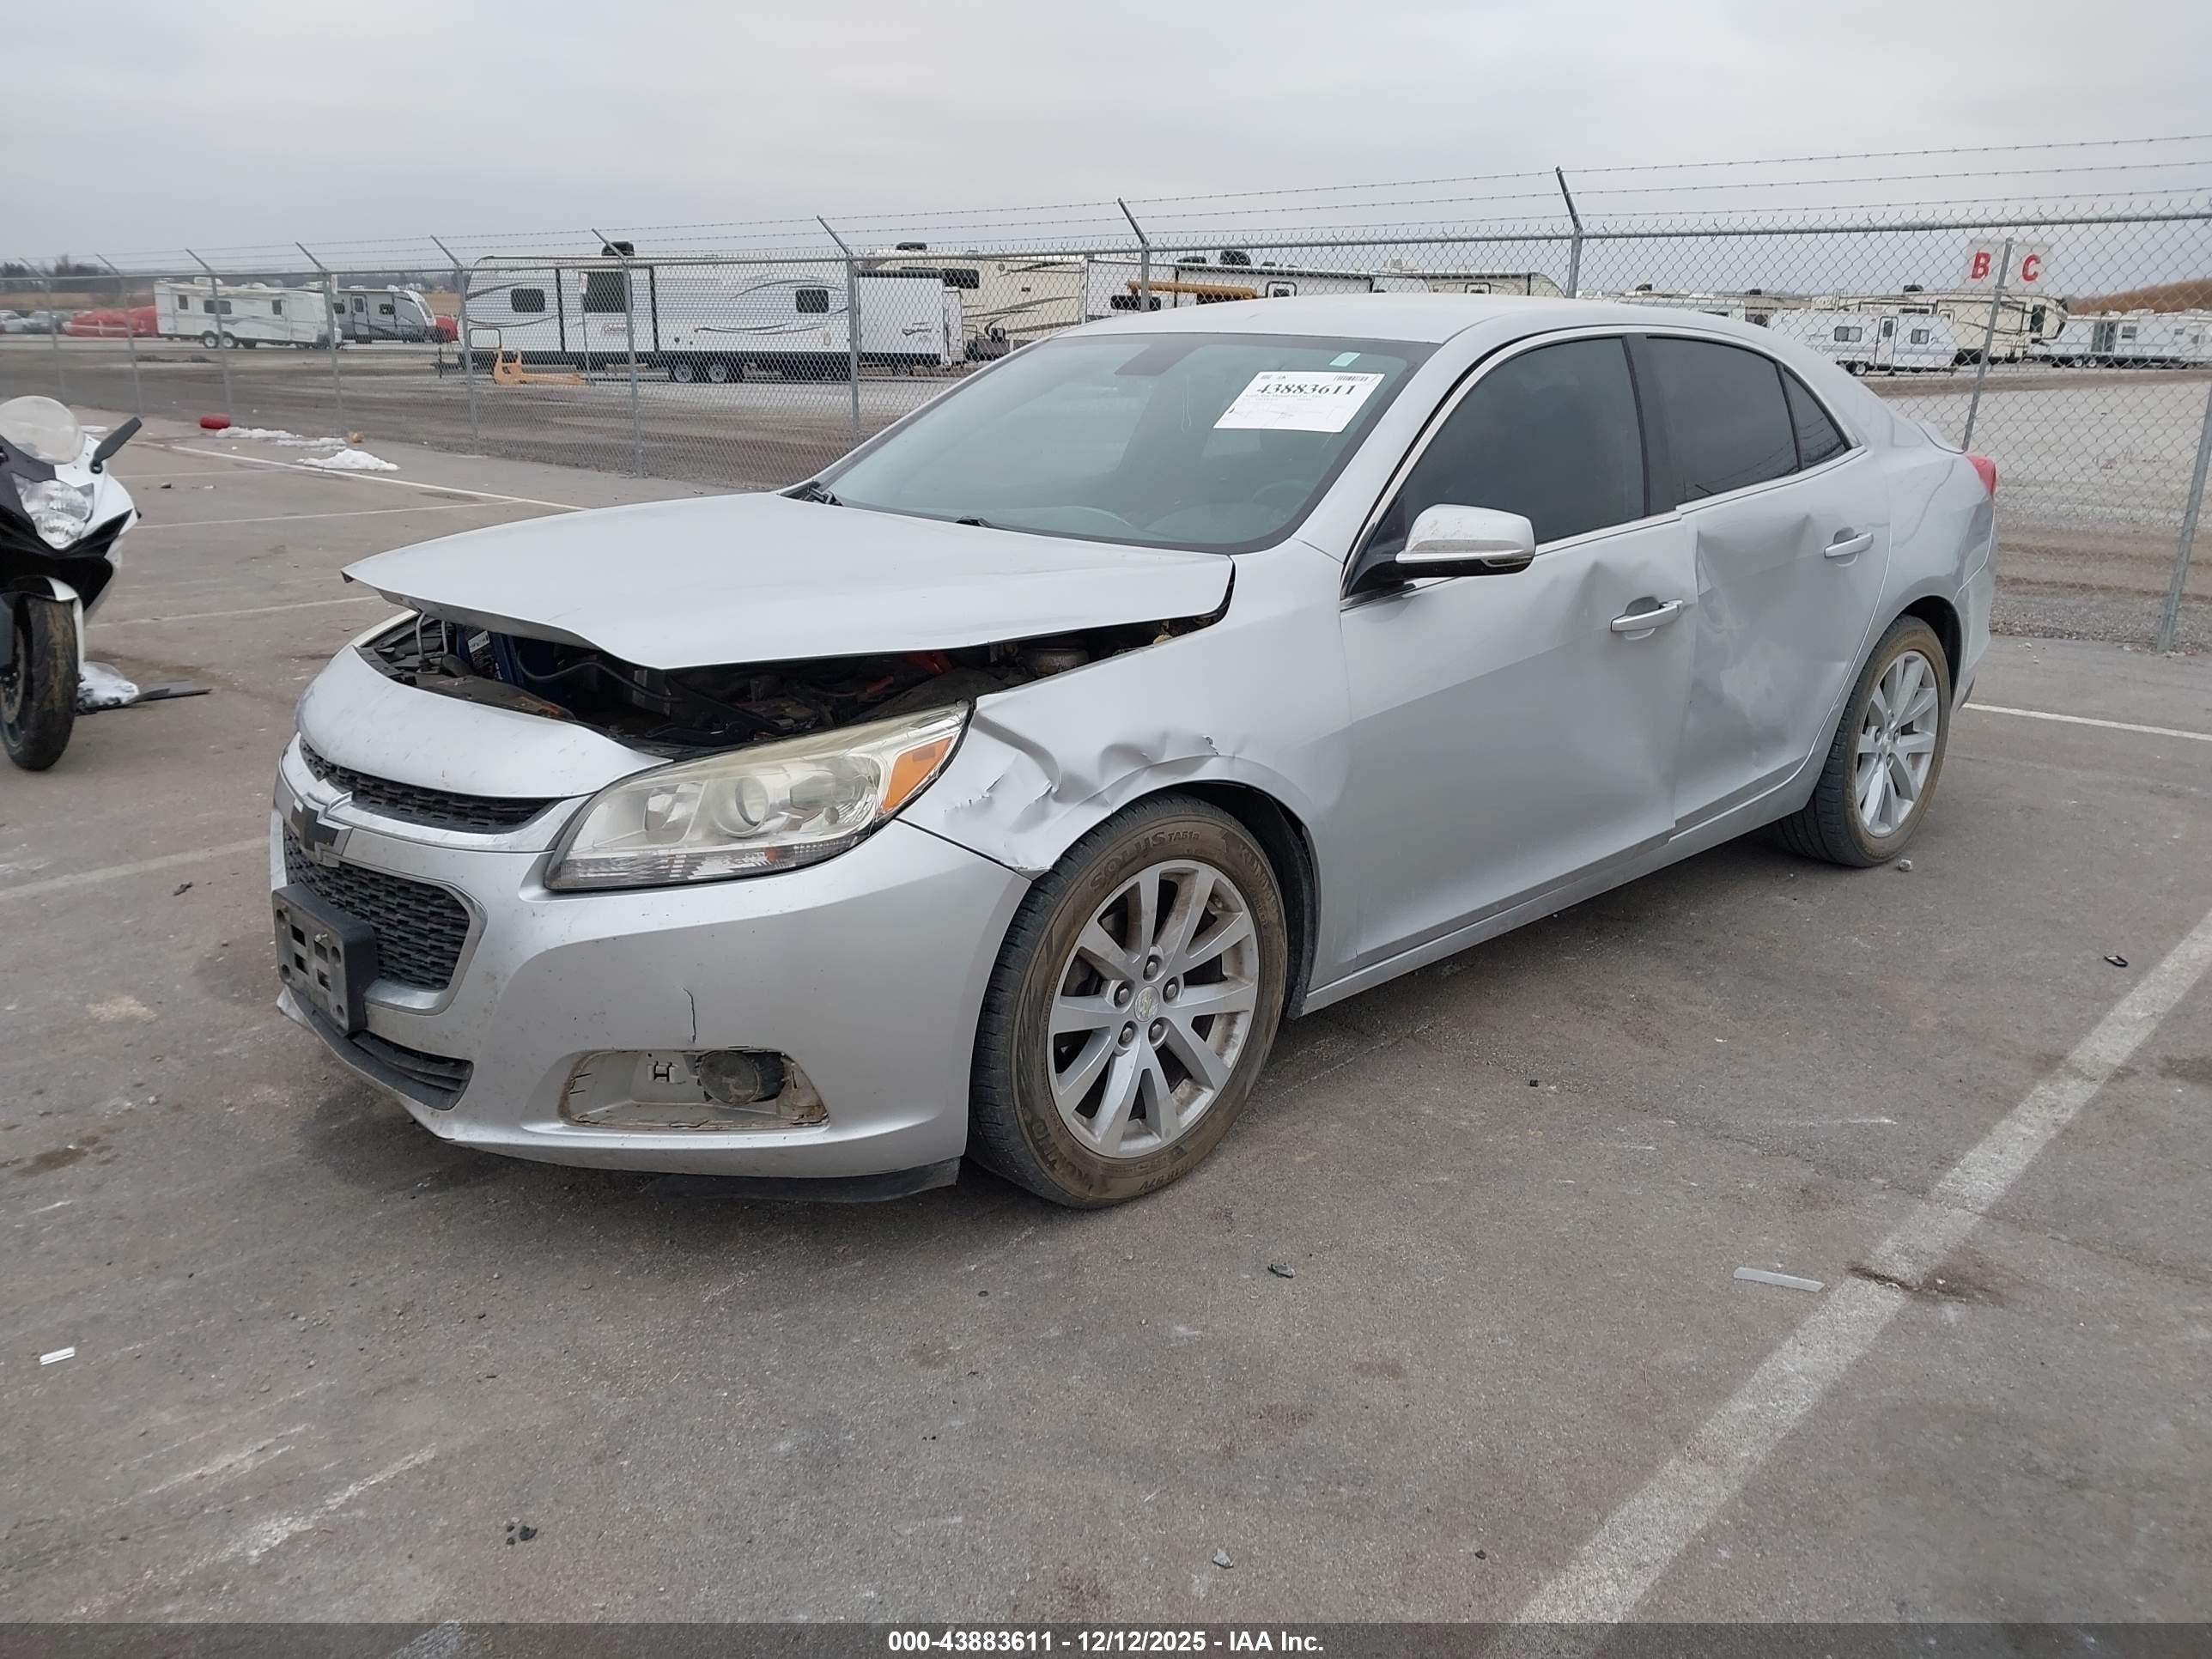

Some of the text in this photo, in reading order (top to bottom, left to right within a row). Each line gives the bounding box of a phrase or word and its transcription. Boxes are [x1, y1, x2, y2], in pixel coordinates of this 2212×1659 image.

[1972, 252, 2041, 282] B C
[1258, 384, 1356, 395] 43883611
